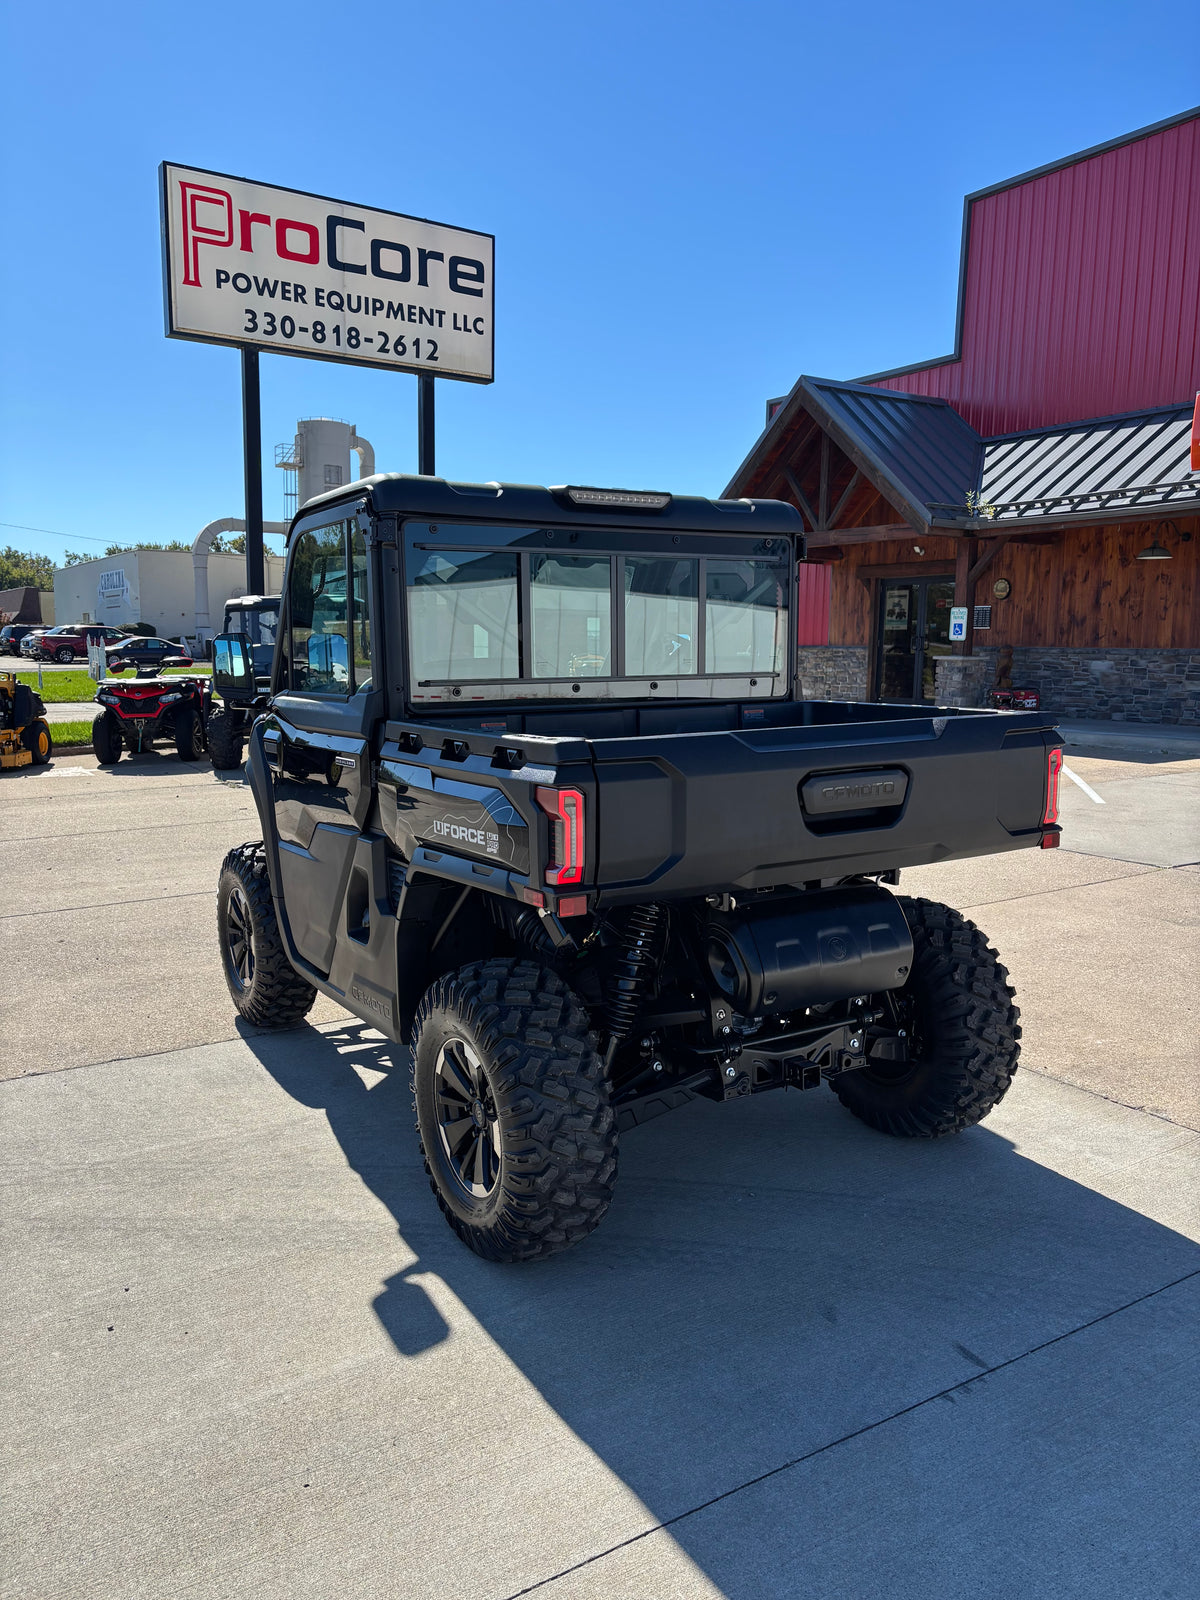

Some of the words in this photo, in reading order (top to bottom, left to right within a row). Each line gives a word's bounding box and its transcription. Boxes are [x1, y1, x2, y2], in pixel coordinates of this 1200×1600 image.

[179, 181, 486, 298] ProCore
[216, 269, 308, 304] POWER
[315, 287, 446, 328] EQUIPMENT
[453, 313, 485, 336] LLC
[244, 309, 440, 362] 330-818-2612
[433, 820, 486, 846] UFORCE
